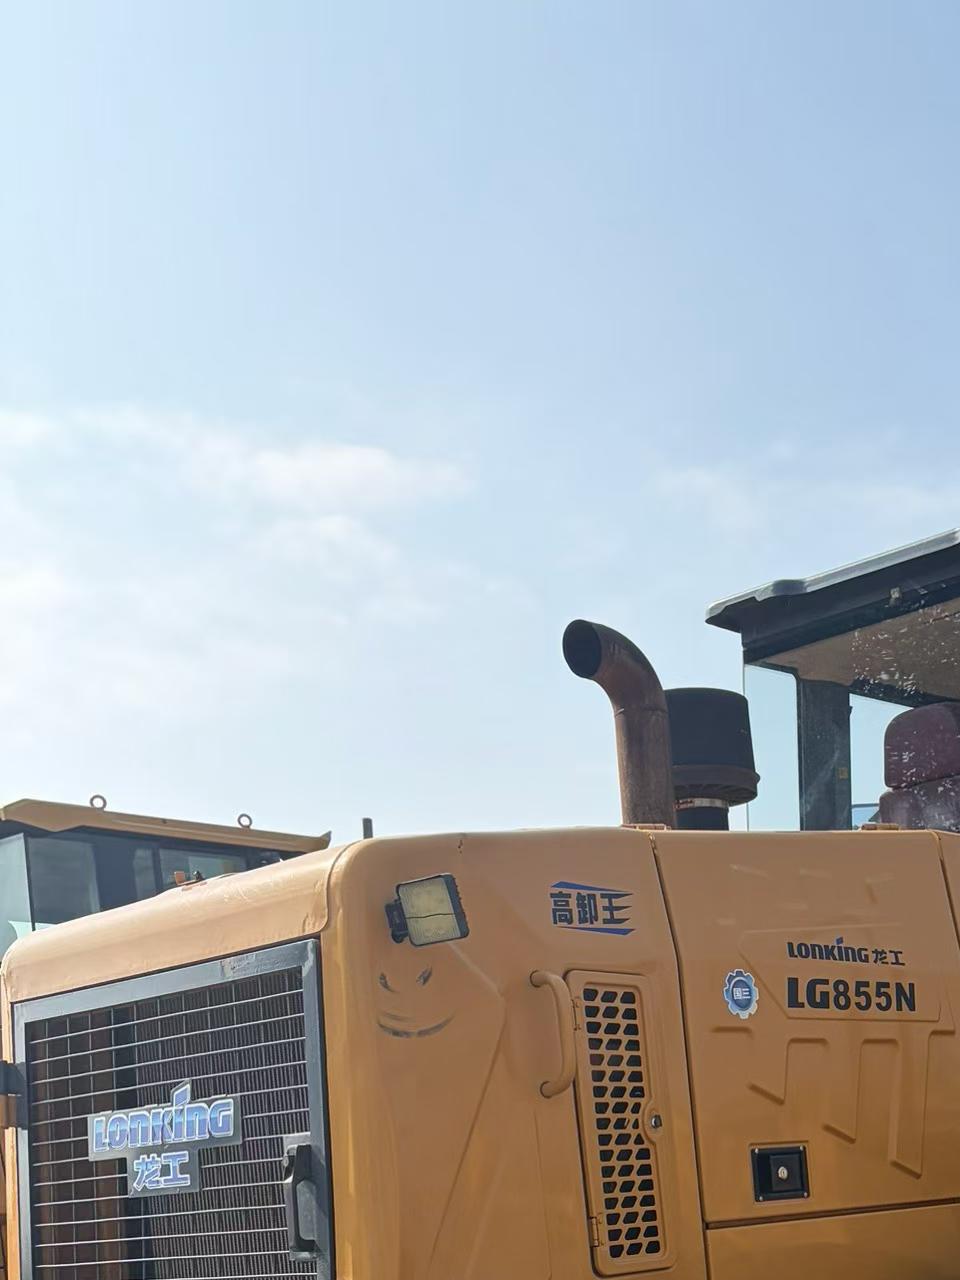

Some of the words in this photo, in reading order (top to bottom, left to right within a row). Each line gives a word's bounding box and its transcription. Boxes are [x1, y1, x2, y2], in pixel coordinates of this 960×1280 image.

[872, 949, 906, 966] 龙工
[787, 977, 916, 1012] LG855N
[133, 1150, 190, 1192] 龙工
